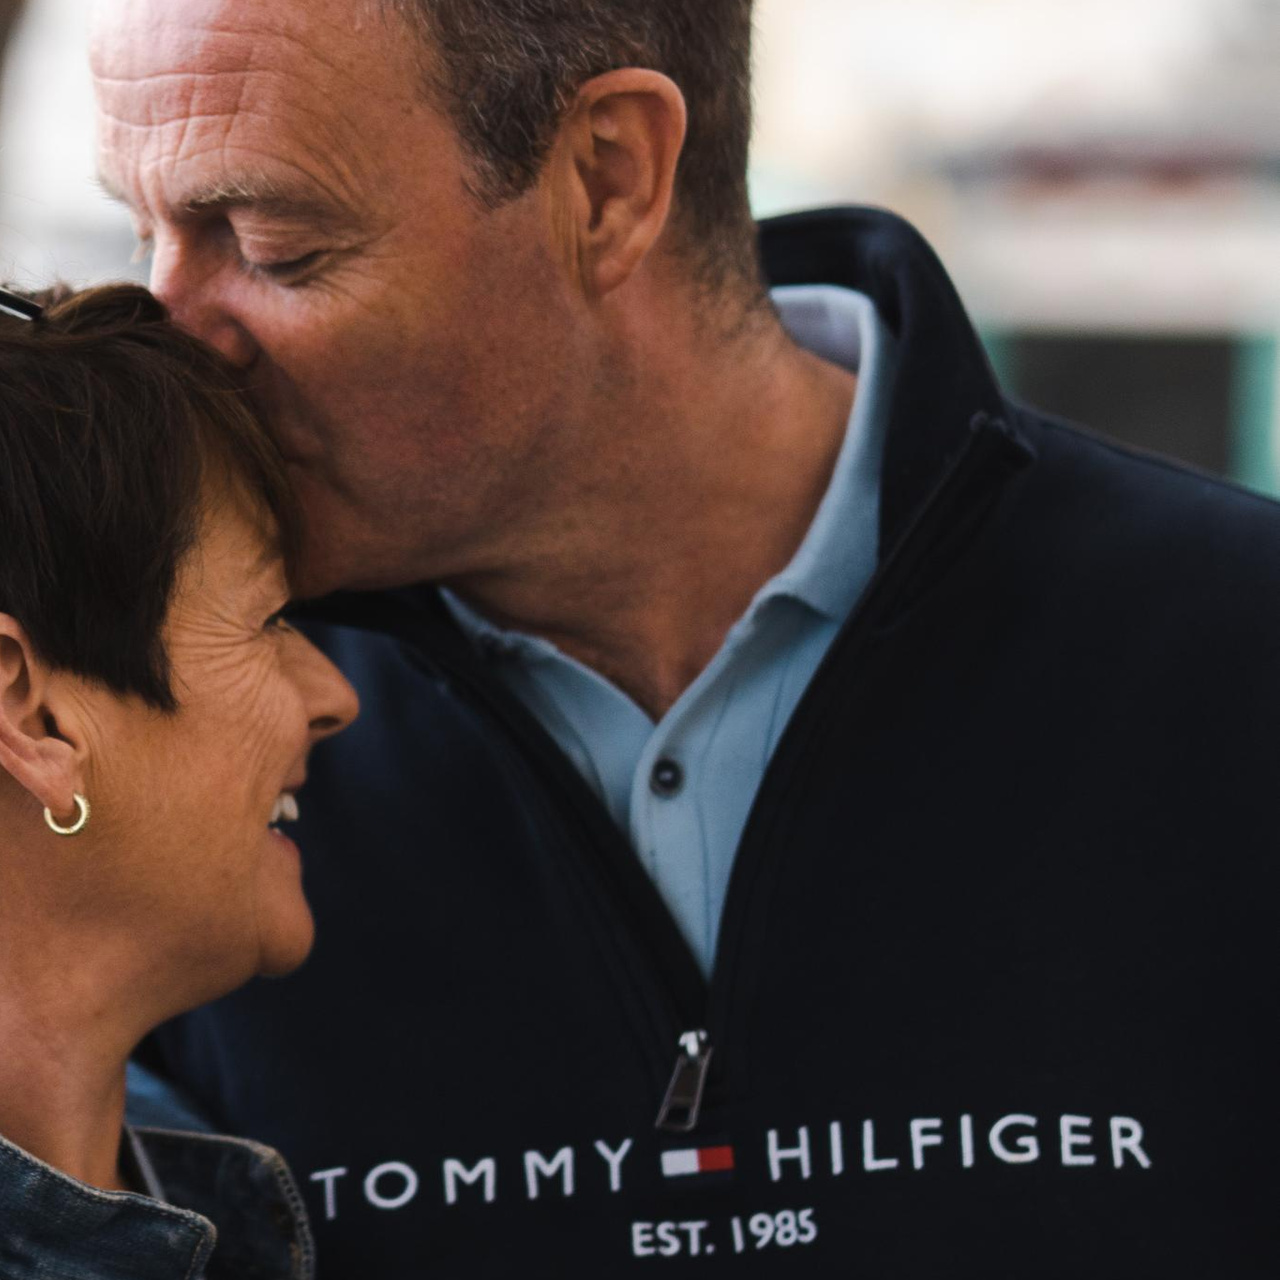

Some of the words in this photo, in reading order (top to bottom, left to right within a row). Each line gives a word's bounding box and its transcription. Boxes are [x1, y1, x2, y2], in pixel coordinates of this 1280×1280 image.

[309, 1139, 632, 1220] TOMMY
[766, 1113, 1152, 1182] HILFIGER
[631, 1220, 716, 1257] EST.
[731, 1207, 818, 1253] 1985
